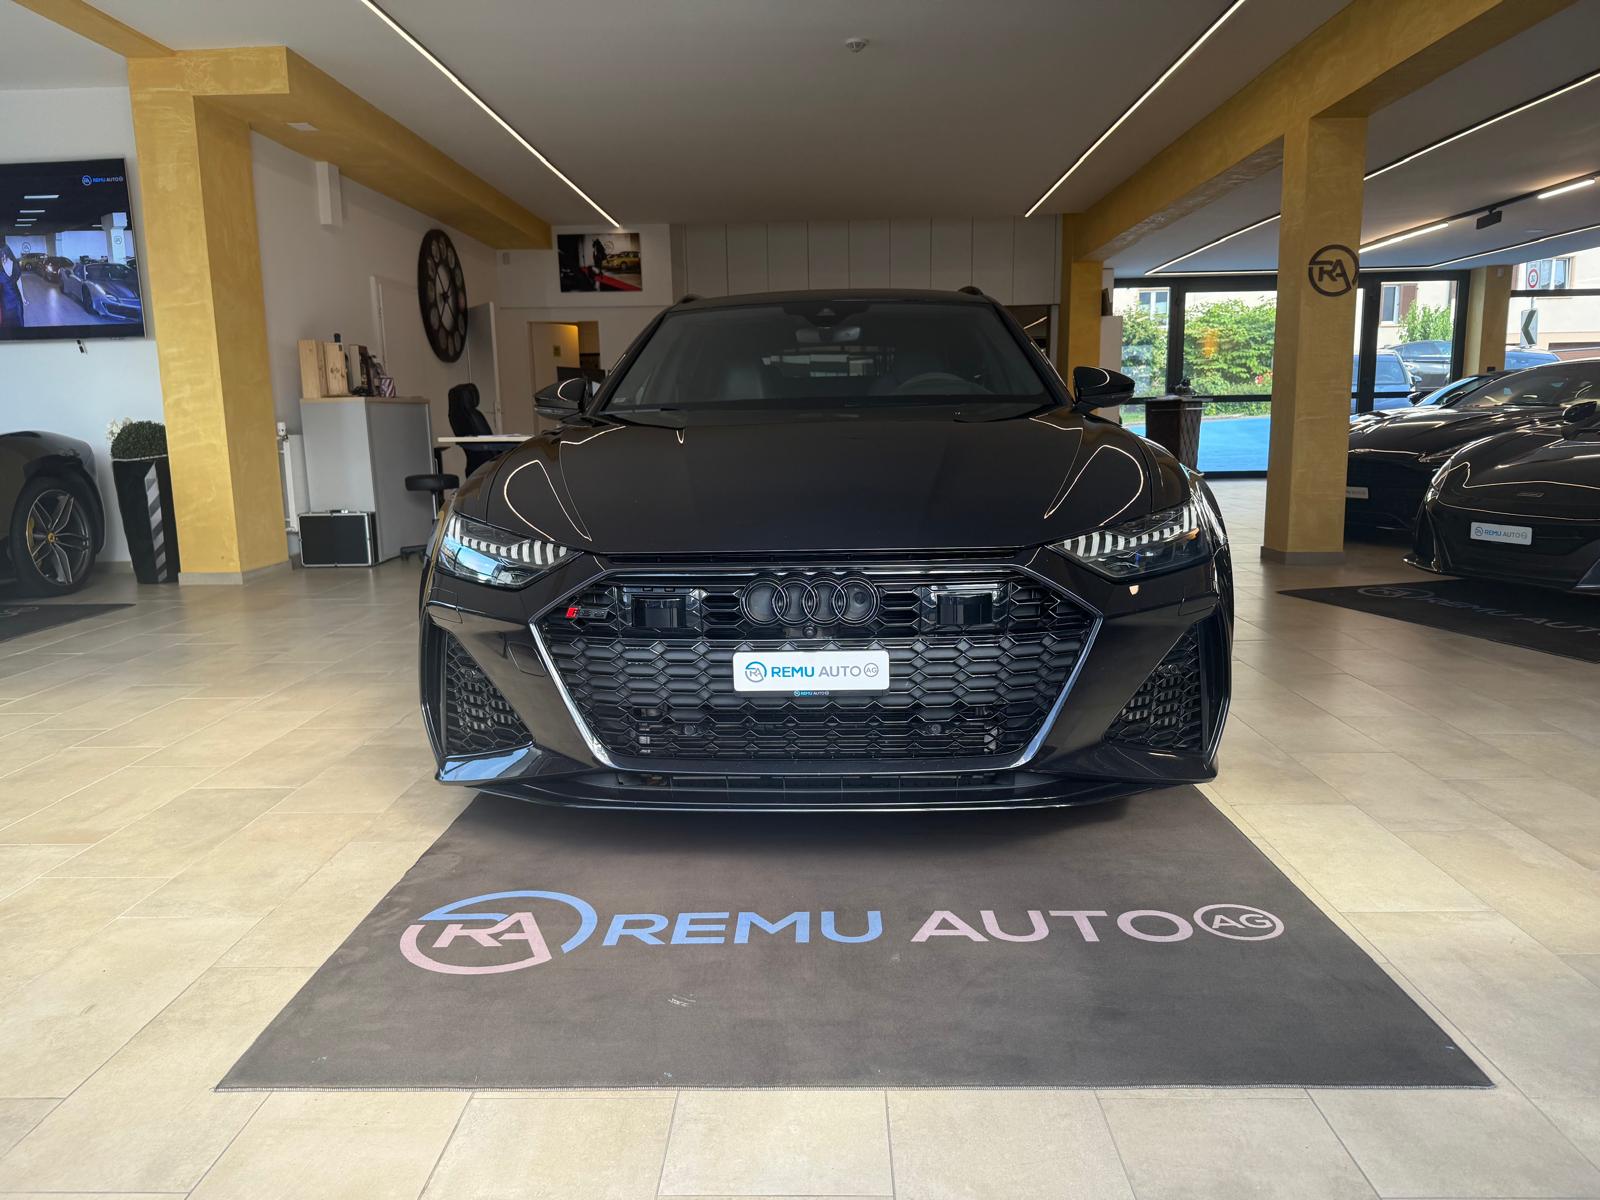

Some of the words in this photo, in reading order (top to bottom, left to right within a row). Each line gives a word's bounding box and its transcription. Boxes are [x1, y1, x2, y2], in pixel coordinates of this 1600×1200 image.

[1484, 529, 1502, 537] REMU
[1511, 615, 1600, 638] AUT
[771, 666, 815, 678] REMU
[818, 665, 862, 678] AUTO
[601, 910, 884, 946] REMU
[909, 909, 1194, 943] AUTO
[1211, 913, 1274, 931] AG
